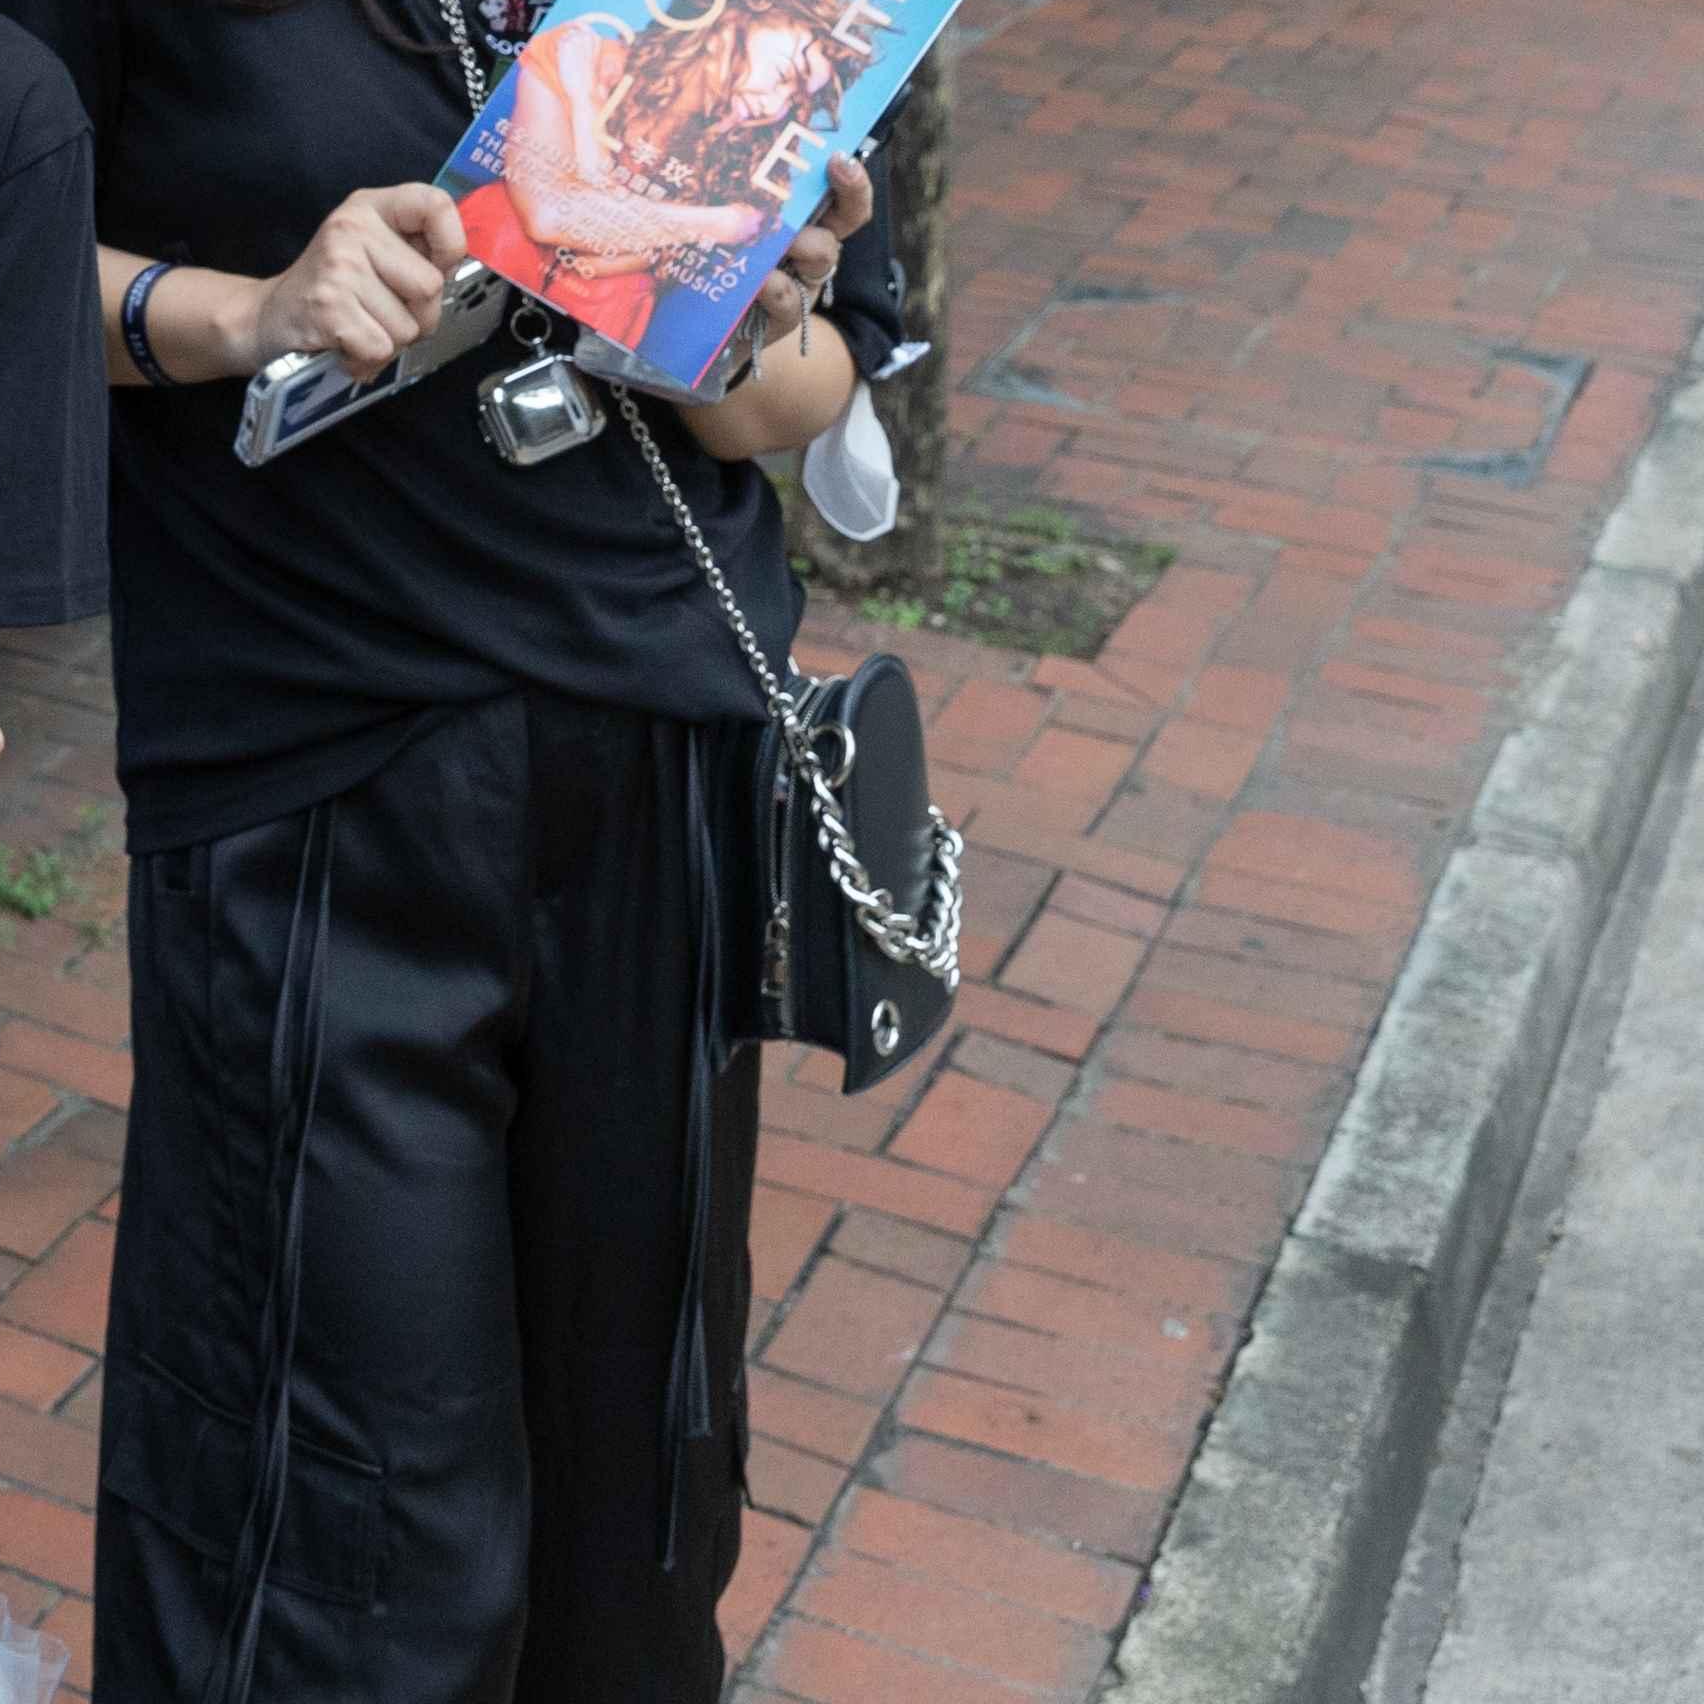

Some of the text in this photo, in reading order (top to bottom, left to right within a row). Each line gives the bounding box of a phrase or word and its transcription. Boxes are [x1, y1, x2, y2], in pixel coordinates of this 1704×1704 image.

[752, 121, 827, 200] E
[660, 257, 726, 304] MUSIC
[709, 265, 740, 291] TO
